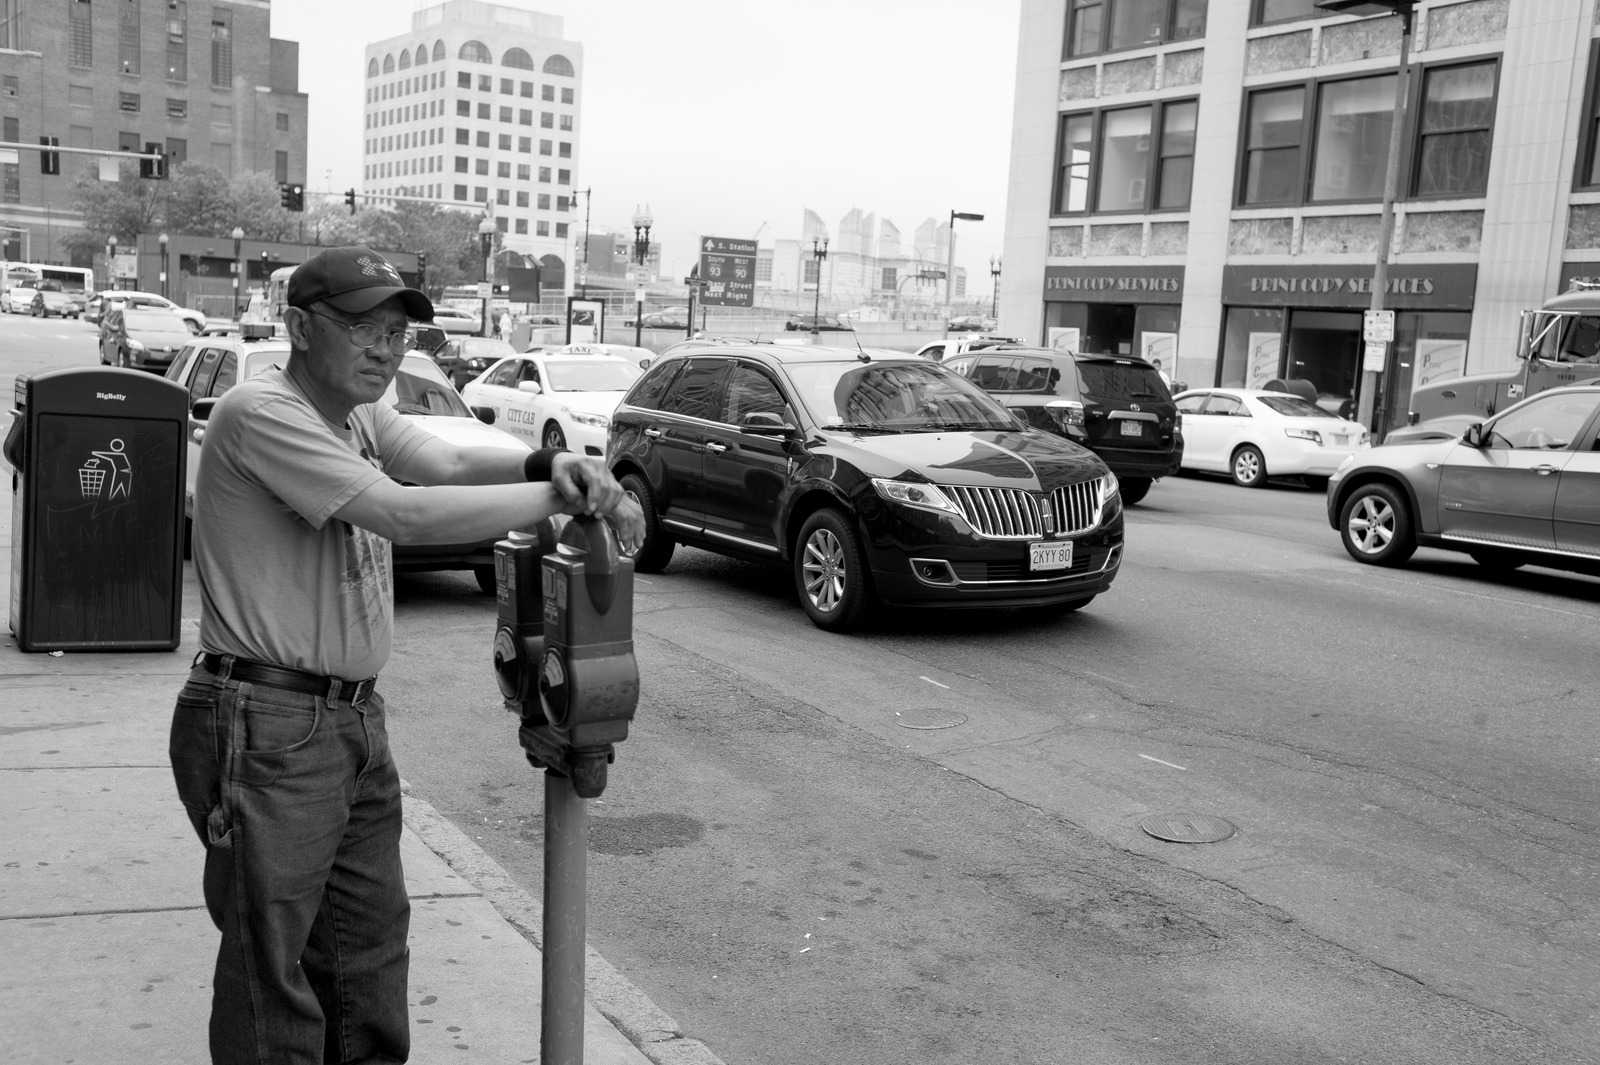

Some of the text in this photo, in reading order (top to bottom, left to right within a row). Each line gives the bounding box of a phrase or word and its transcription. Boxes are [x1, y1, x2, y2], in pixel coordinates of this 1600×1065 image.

[729, 243, 755, 252] Station
[710, 266, 720, 276] 93
[735, 268, 746, 278] 90
[729, 281, 752, 290] Street
[1048, 277, 1179, 292] PRINT COPY SERVICES
[1251, 277, 1298, 292] PRINT
[1300, 277, 1347, 293] COPY
[704, 290, 748, 300] Next Right
[569, 346, 591, 354] TAXI
[96, 392, 126, 401] BigBelly
[508, 408, 522, 423] CITY
[522, 410, 536, 425] CAB
[1033, 548, 1070, 564] 2KYY 80
